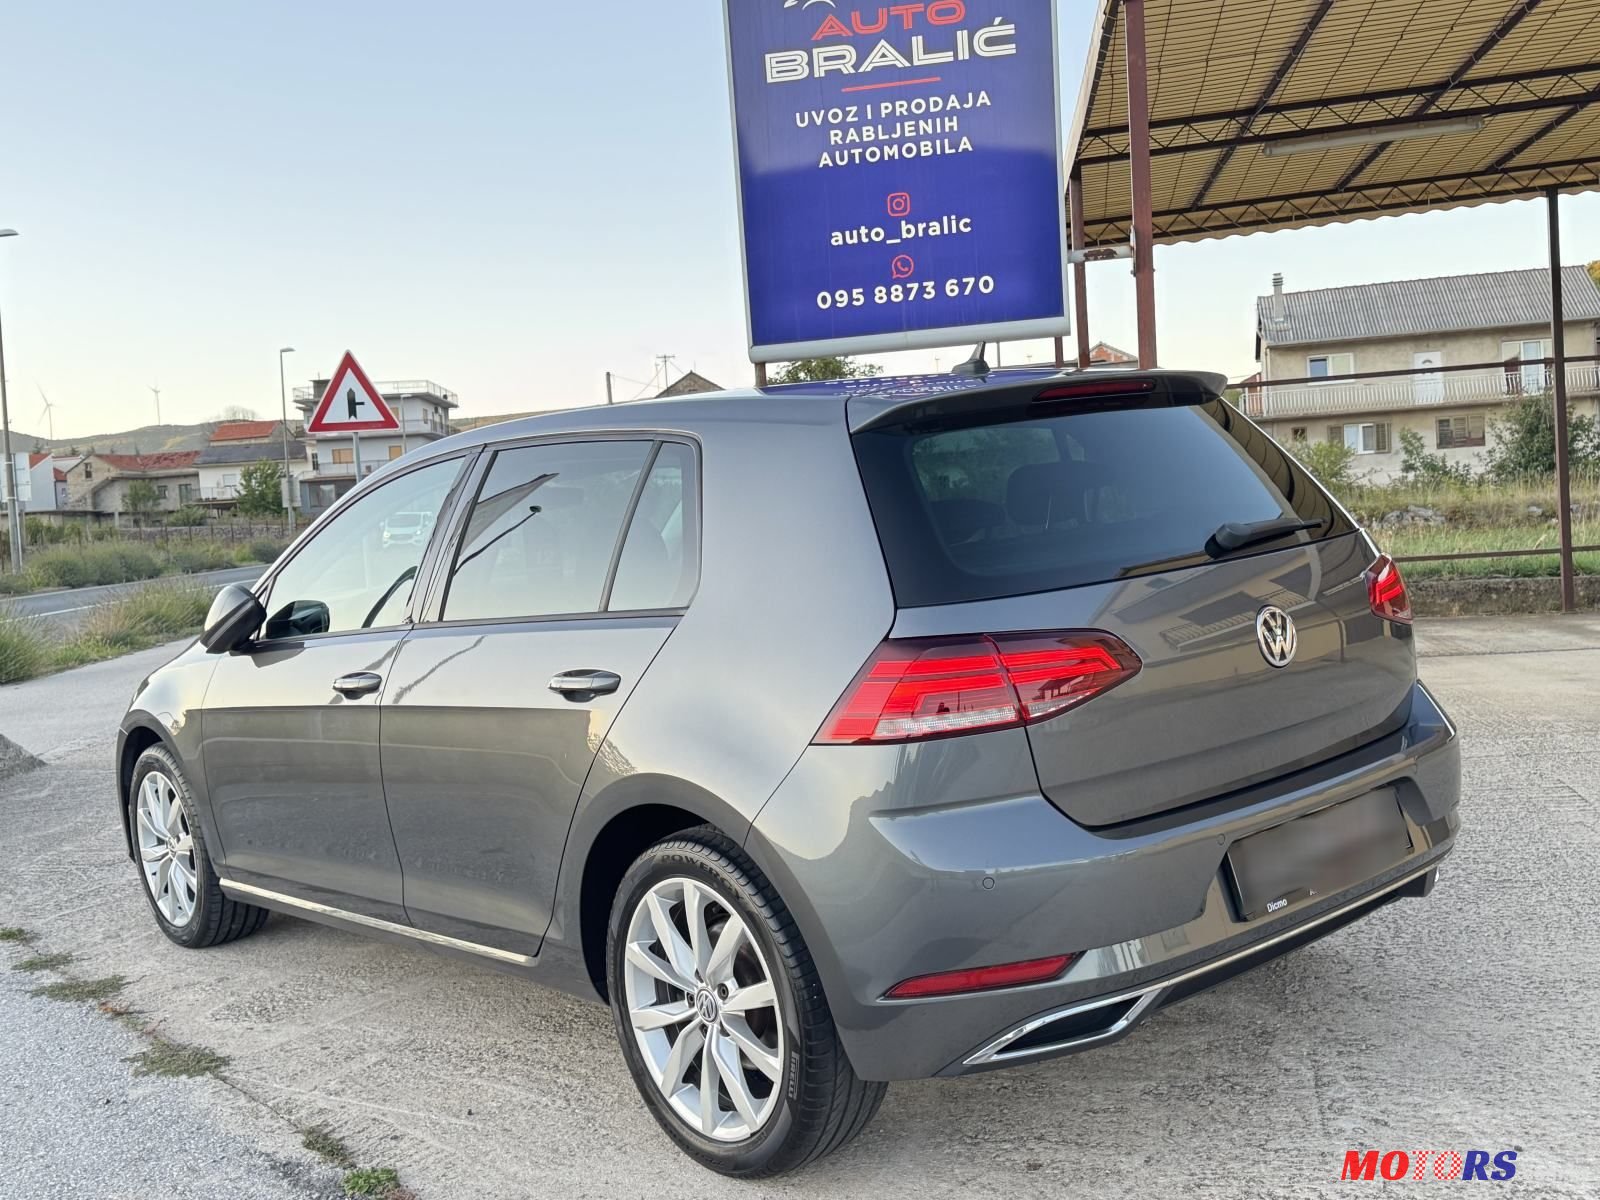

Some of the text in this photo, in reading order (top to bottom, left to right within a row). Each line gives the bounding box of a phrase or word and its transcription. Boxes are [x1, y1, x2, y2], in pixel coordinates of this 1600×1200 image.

[811, 0, 966, 41] AUTO
[764, 17, 1017, 84] BRALIĆ
[795, 91, 992, 128] UVOZ I PRODAJA
[829, 116, 959, 145] RABLJENIH
[818, 137, 974, 168] AUTOMOBILA
[830, 215, 972, 246] auto_bralic
[816, 275, 995, 309] 095 8873 670
